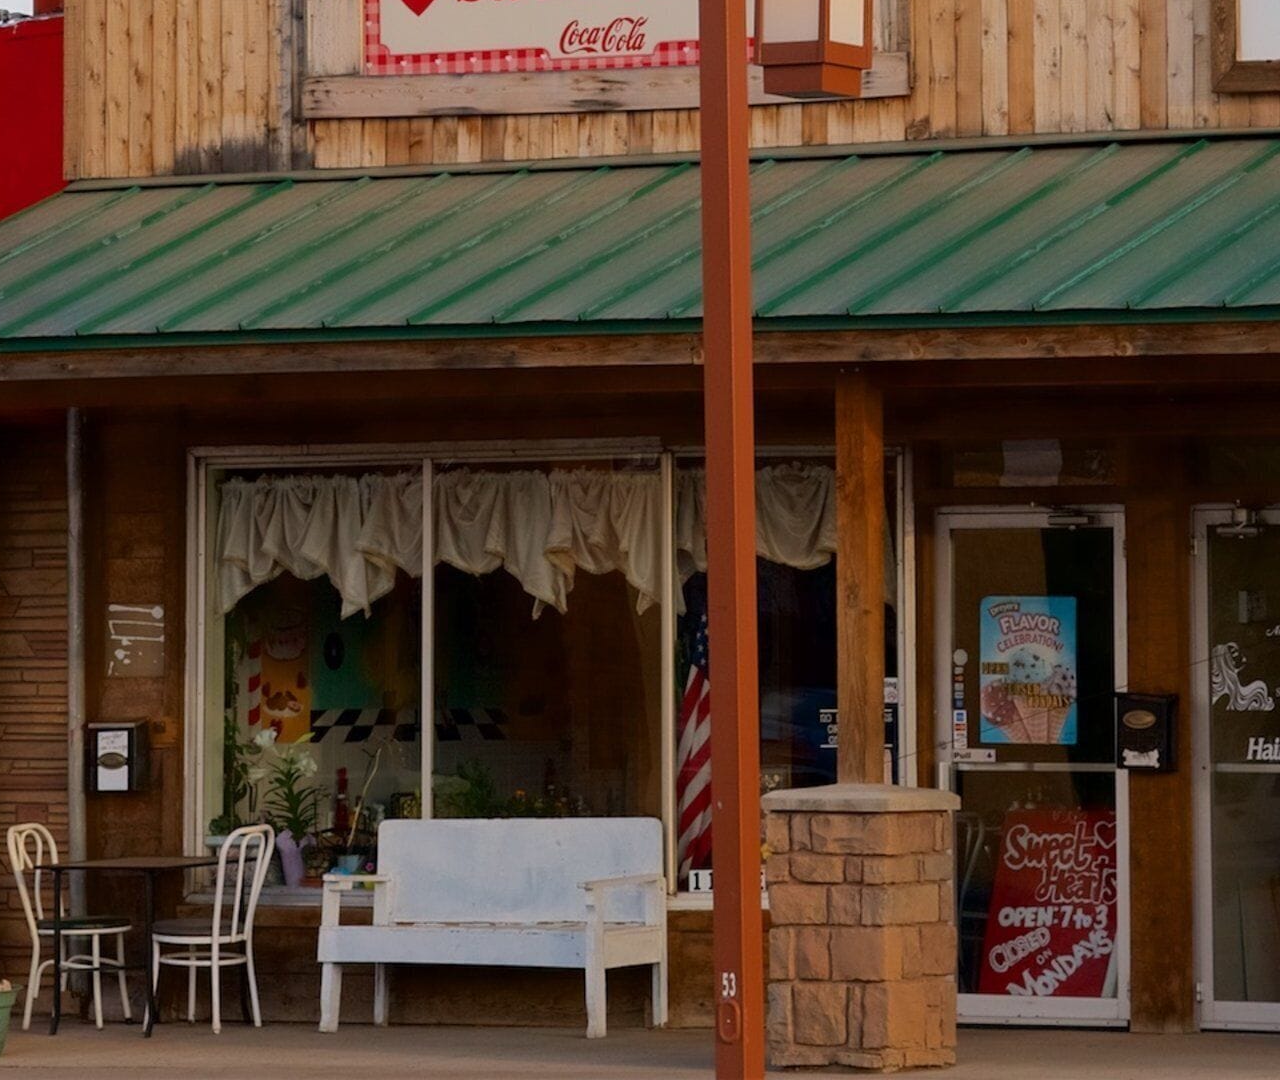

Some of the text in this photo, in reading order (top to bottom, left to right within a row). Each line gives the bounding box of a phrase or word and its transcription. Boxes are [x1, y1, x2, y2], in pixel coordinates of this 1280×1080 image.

[559, 17, 649, 54] Coca-Cola
[1000, 613, 1061, 635] FLAVOR
[997, 633, 1064, 653] CELEBRATION!
[1004, 821, 1097, 871] Sweet
[998, 904, 1108, 929] OPEN: 7 to 3
[988, 926, 1051, 973] CLOSED
[1006, 929, 1113, 996] MONDAYS
[722, 972, 736, 997] 53
